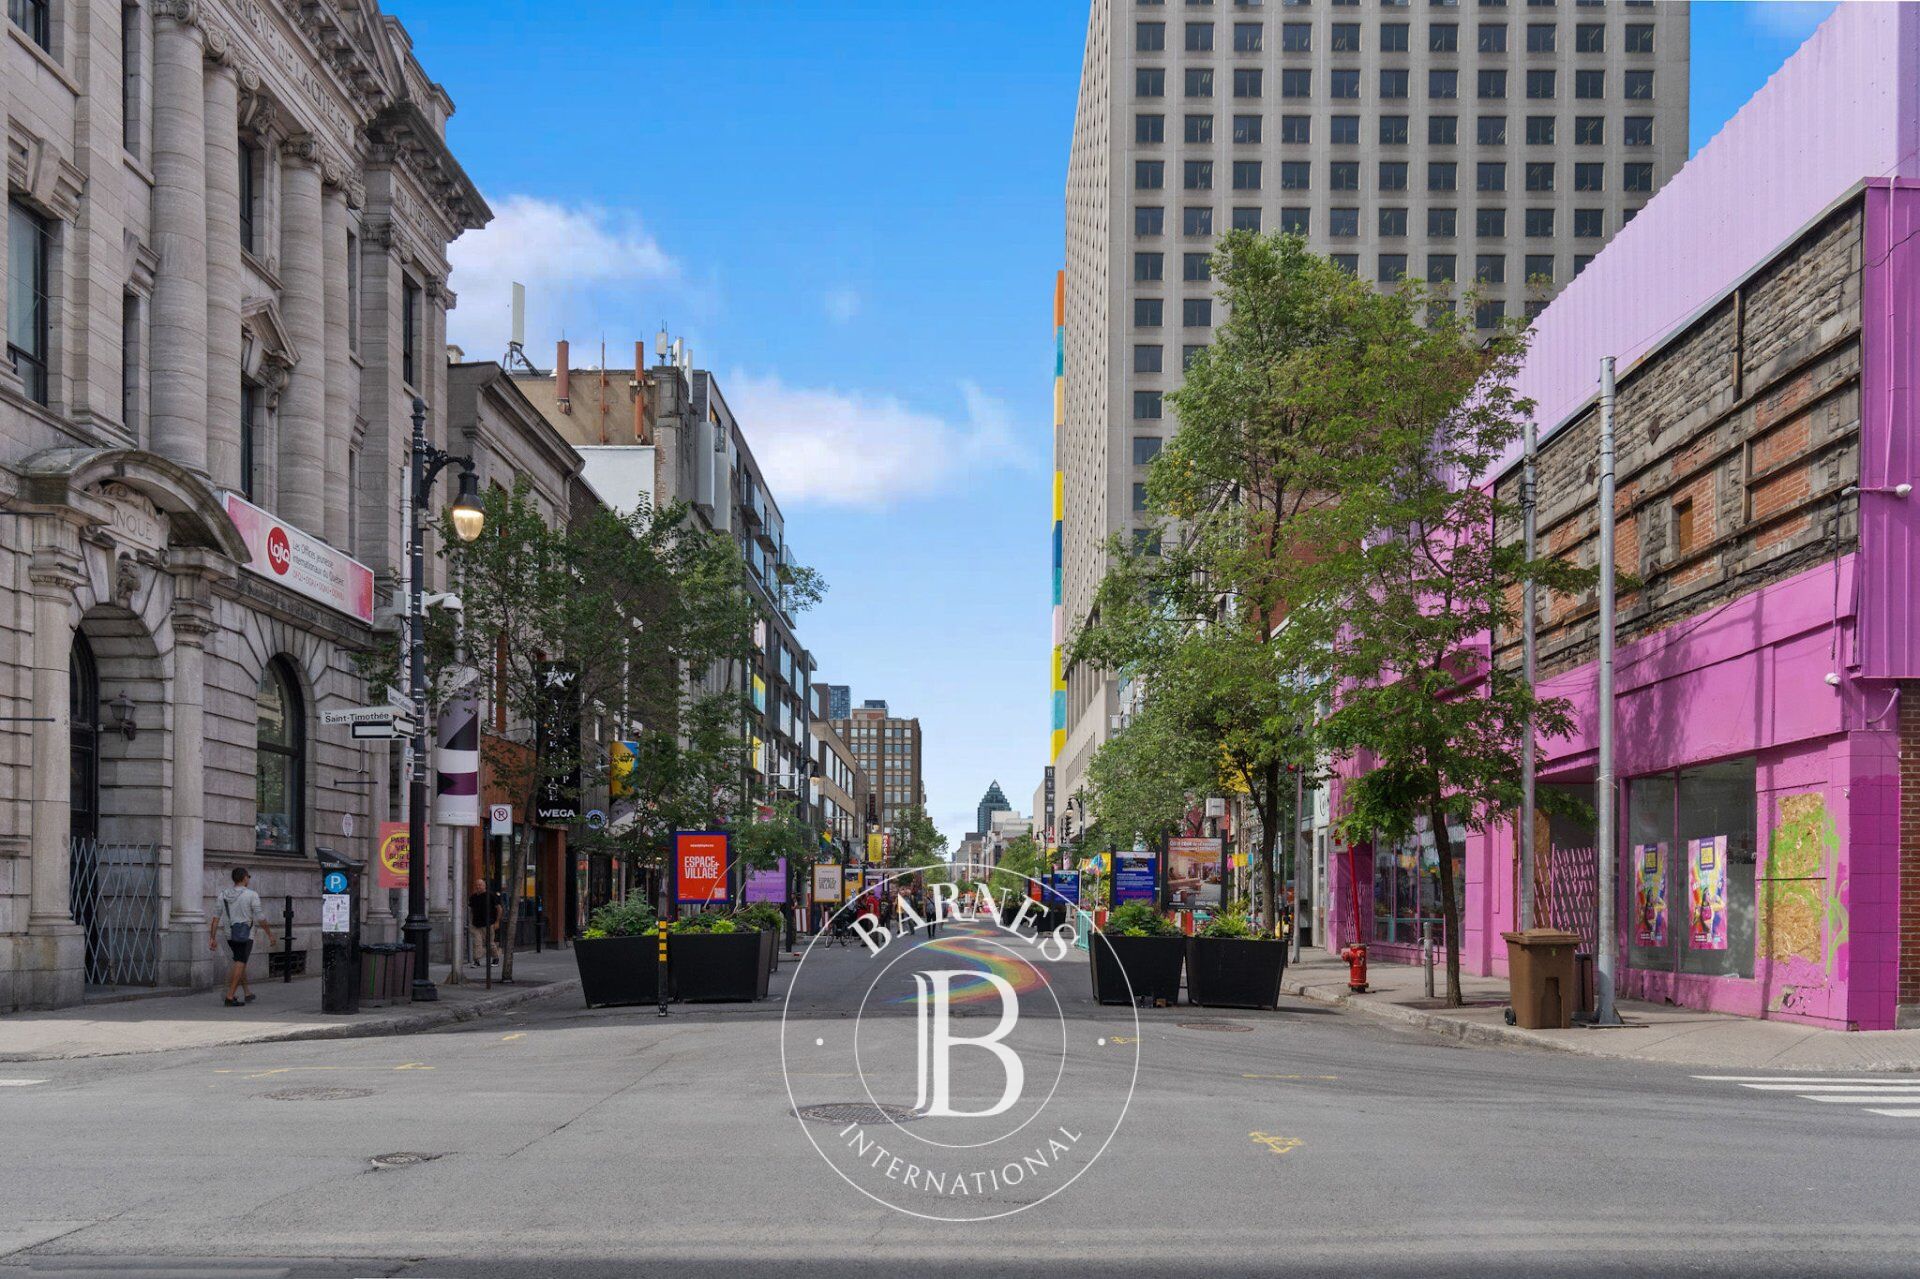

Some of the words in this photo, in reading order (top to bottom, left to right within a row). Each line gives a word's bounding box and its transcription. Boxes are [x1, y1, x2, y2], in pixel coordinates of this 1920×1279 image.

[113, 508, 152, 542] NQUE
[539, 809, 575, 818] WEGA
[685, 867, 718, 879] VILLAGE
